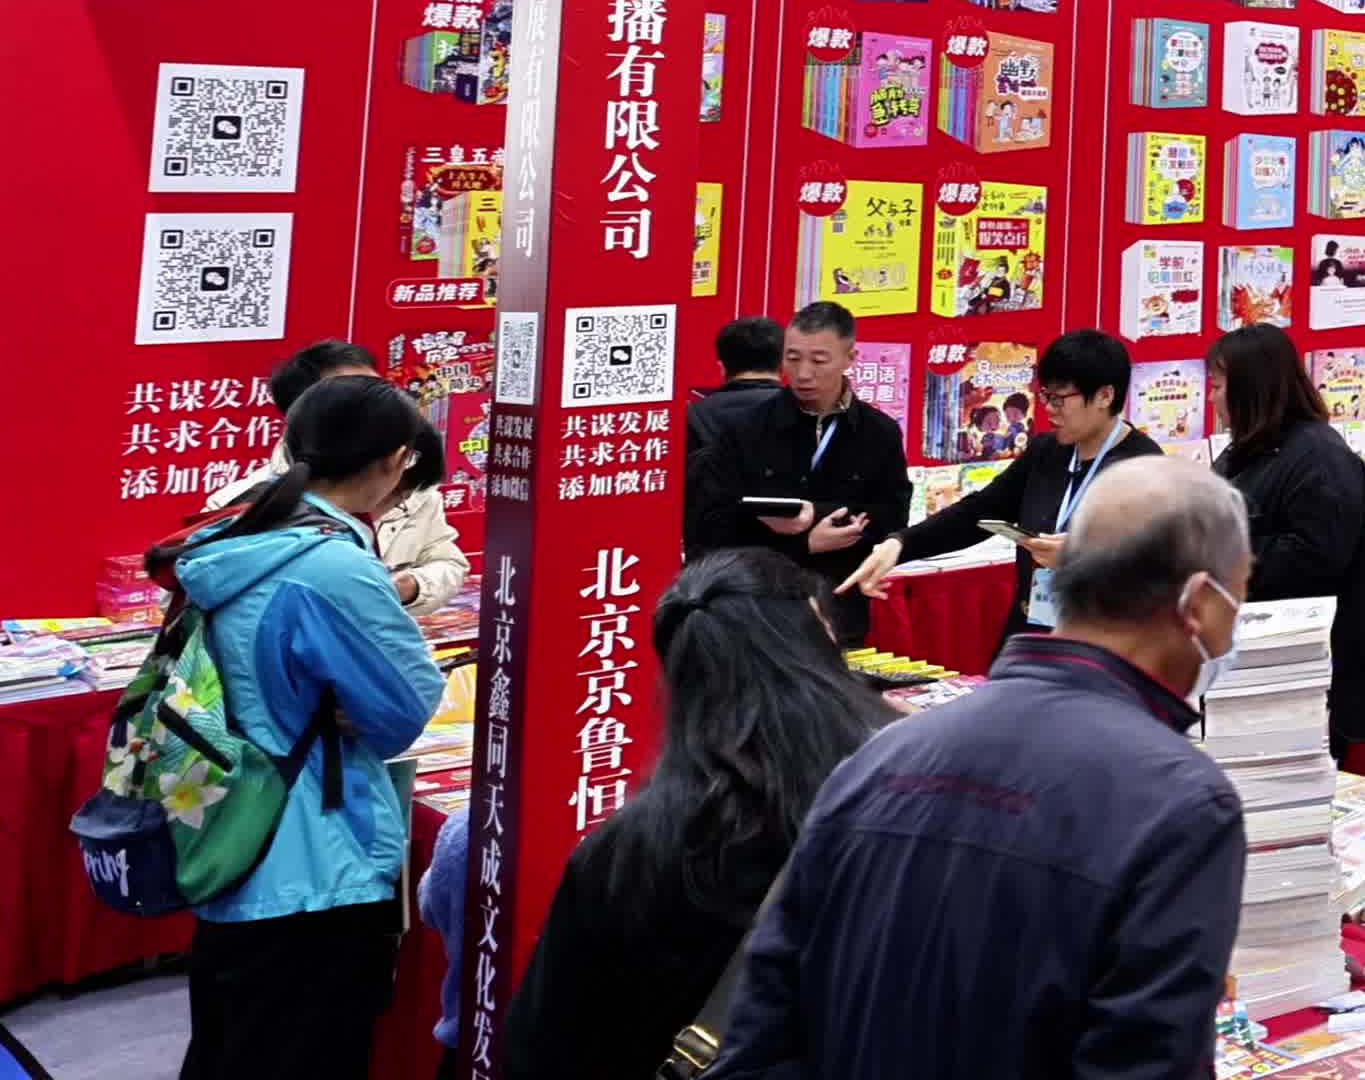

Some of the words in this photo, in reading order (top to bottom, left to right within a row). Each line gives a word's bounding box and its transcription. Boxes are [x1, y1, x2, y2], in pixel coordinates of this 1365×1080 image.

[421, 3, 484, 29] 爆款
[808, 27, 853, 50] 爆款
[946, 35, 988, 57] 爆款
[800, 182, 844, 203] 爆款
[937, 183, 980, 204] 爆款
[392, 282, 481, 303] 新品推荐
[928, 345, 967, 364] 爆款
[121, 417, 284, 455] 共求合作
[560, 409, 671, 440] 共谋发展
[558, 437, 669, 469] 共求合作
[557, 469, 667, 502] 添加微信
[472, 556, 517, 1080] 北京鑫同天成文化发
